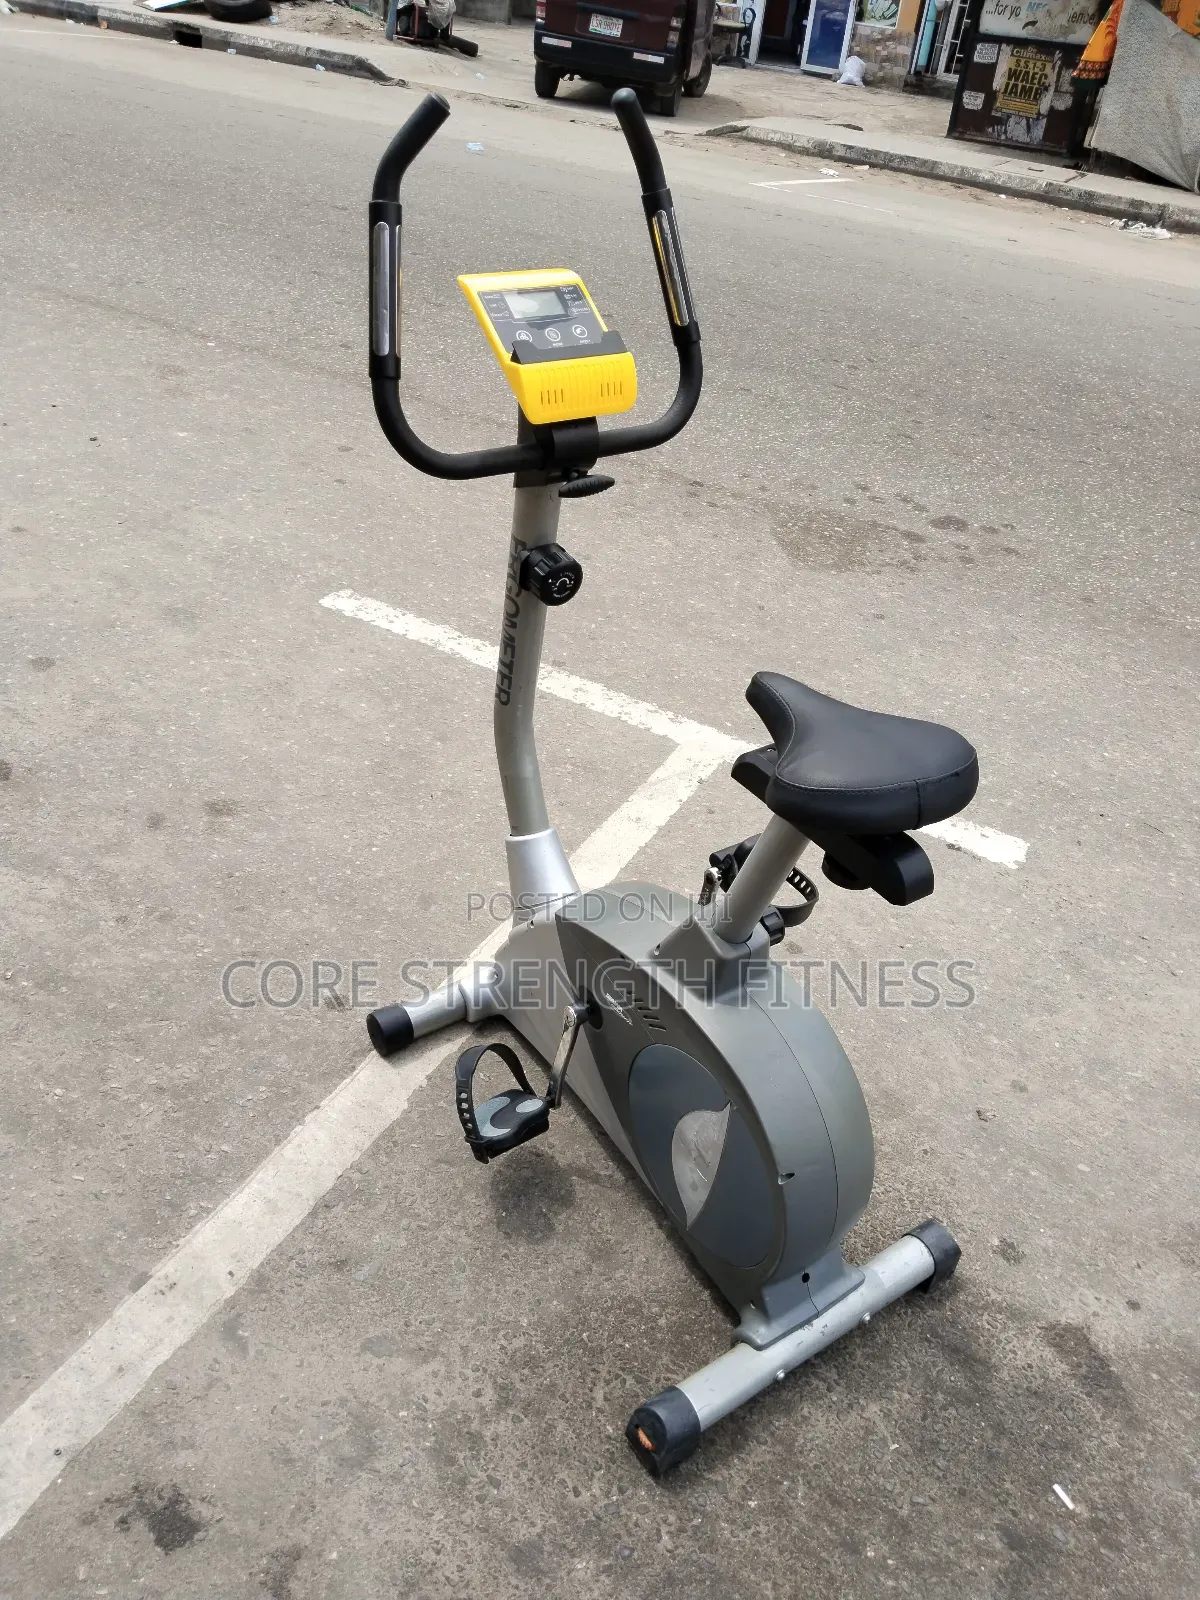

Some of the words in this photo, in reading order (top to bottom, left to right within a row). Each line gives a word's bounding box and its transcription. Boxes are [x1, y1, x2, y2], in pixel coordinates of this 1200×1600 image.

[1008, 5, 1022, 20] yo
[1013, 48, 1047, 61] Climax
[1007, 67, 1049, 88] WAEC
[1002, 82, 1044, 101] JAMB
